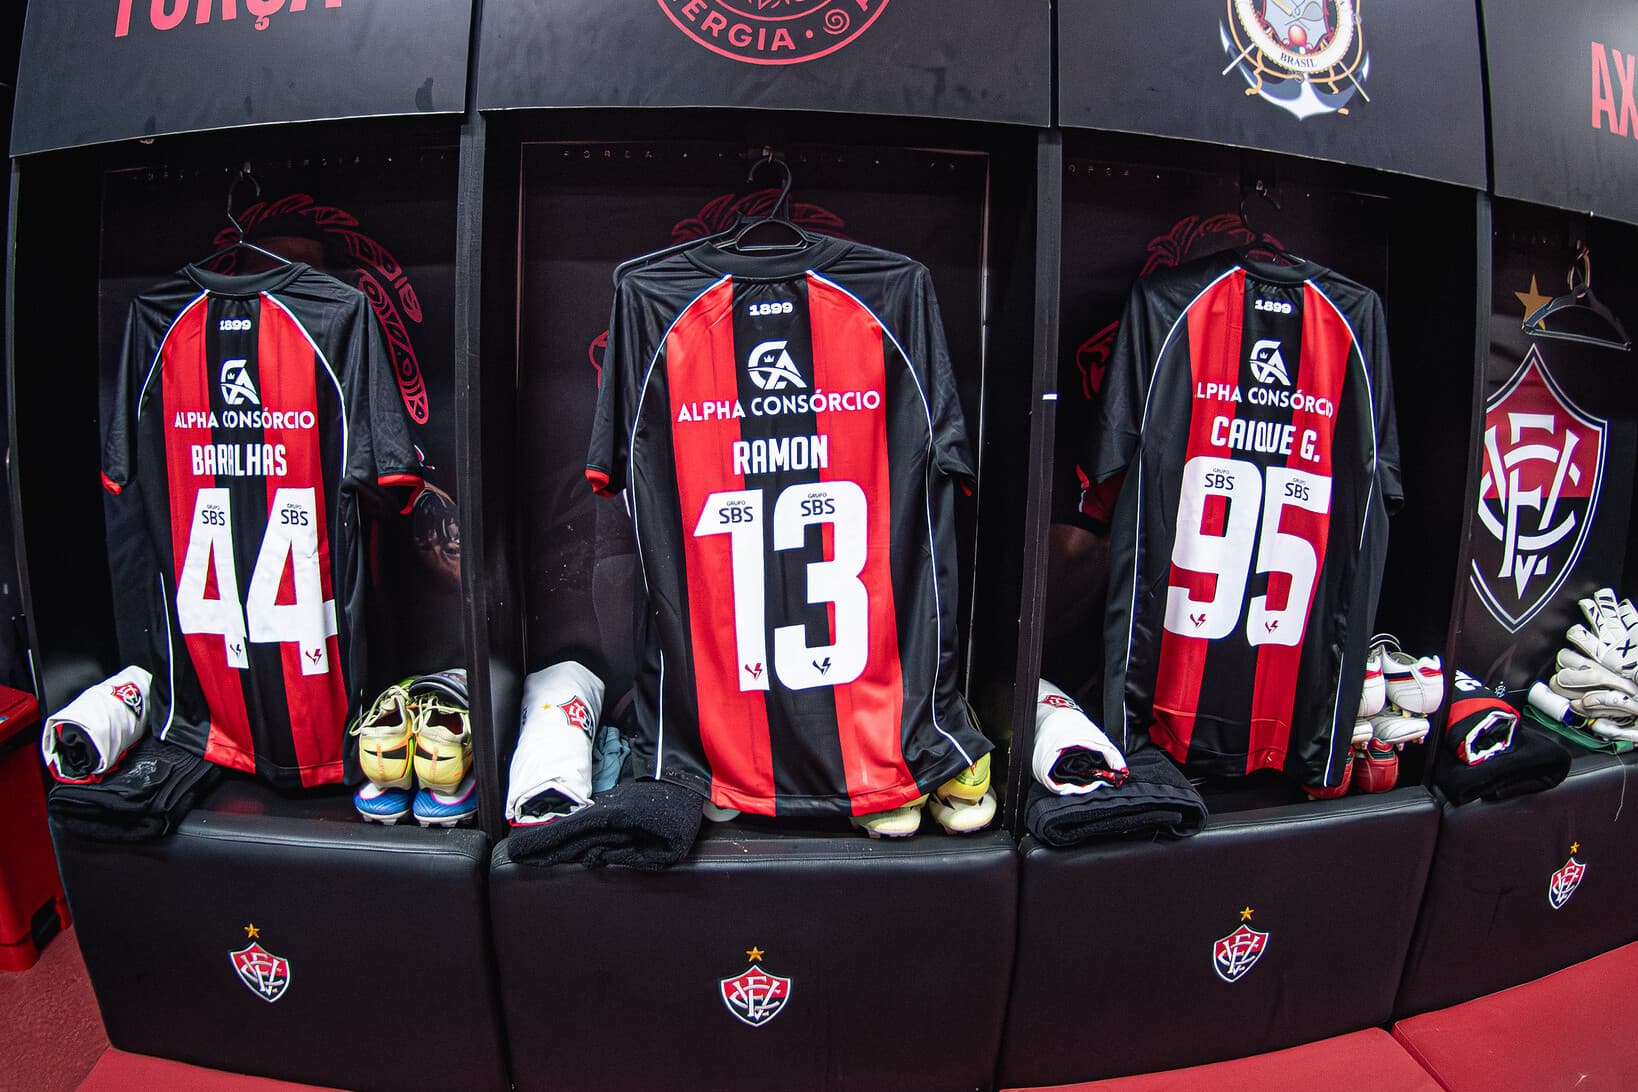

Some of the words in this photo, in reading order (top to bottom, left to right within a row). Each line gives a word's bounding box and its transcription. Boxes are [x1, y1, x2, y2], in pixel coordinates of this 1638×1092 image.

[673, 0, 796, 51] ERGIA
[1280, 53, 1318, 69] BRASIL
[748, 302, 794, 316] 1899
[1254, 299, 1292, 314] 1899
[219, 319, 252, 331] 1899
[1194, 382, 1243, 403] LPHA
[677, 397, 746, 423] ALPHA
[751, 389, 881, 417] CONSÓRCIO
[174, 411, 219, 429] ALPHA
[222, 407, 315, 429] CONSÓRCIO
[1210, 415, 1296, 456] CAIQUE
[1300, 429, 1321, 463] G.
[191, 444, 287, 477] BARALHAS
[732, 435, 829, 475] RAMON
[1204, 473, 1235, 490] SBS
[1284, 482, 1310, 501] SBS
[718, 506, 754, 524] SBS
[800, 498, 836, 517] SBS
[201, 510, 226, 526] SBS
[280, 509, 309, 527] SBS
[1163, 456, 1332, 648] 95
[176, 487, 338, 676] 44
[693, 480, 868, 692] 13
